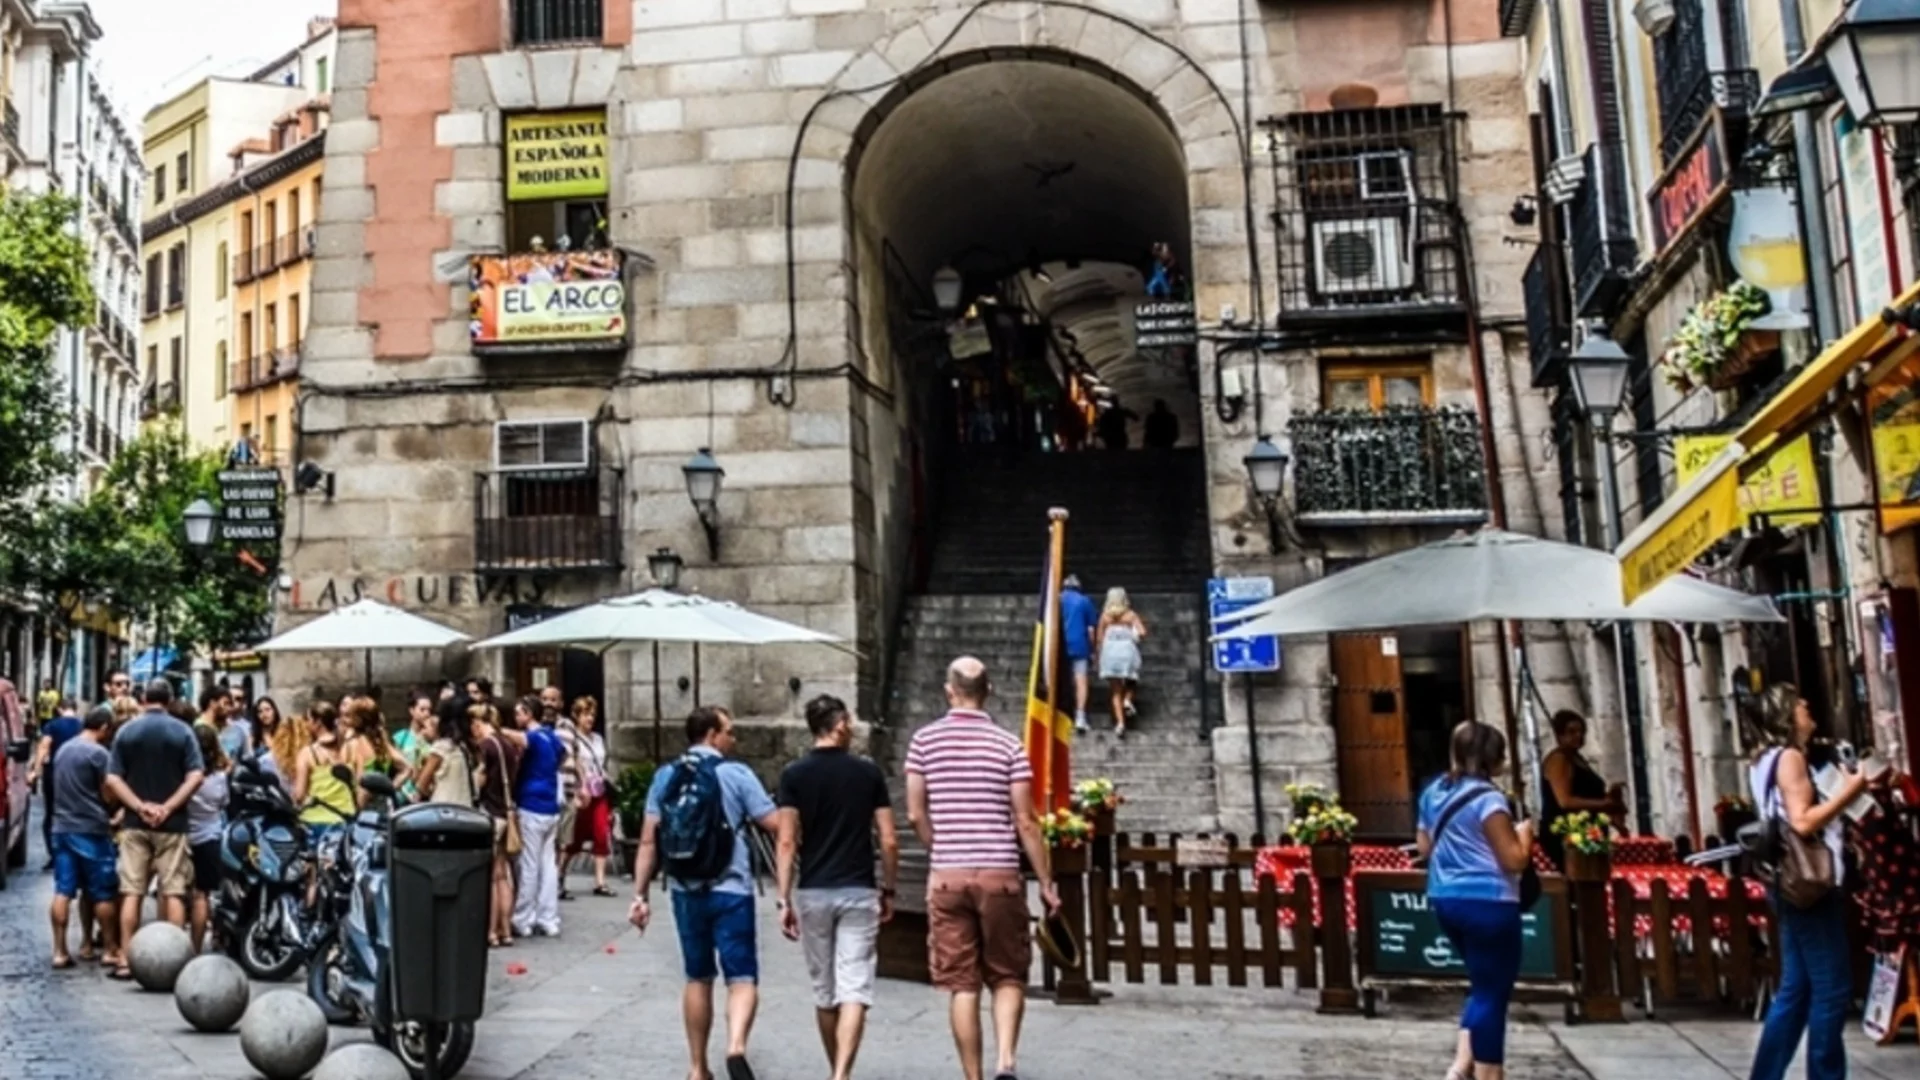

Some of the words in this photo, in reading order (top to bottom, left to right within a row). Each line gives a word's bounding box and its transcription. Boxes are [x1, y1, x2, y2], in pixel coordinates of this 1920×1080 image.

[515, 143, 603, 162] ESPAÑOLA
[517, 166, 600, 184] MODERNA
[504, 288, 536, 313] EL
[546, 284, 622, 310] ARCO
[291, 577, 367, 608] LAS
